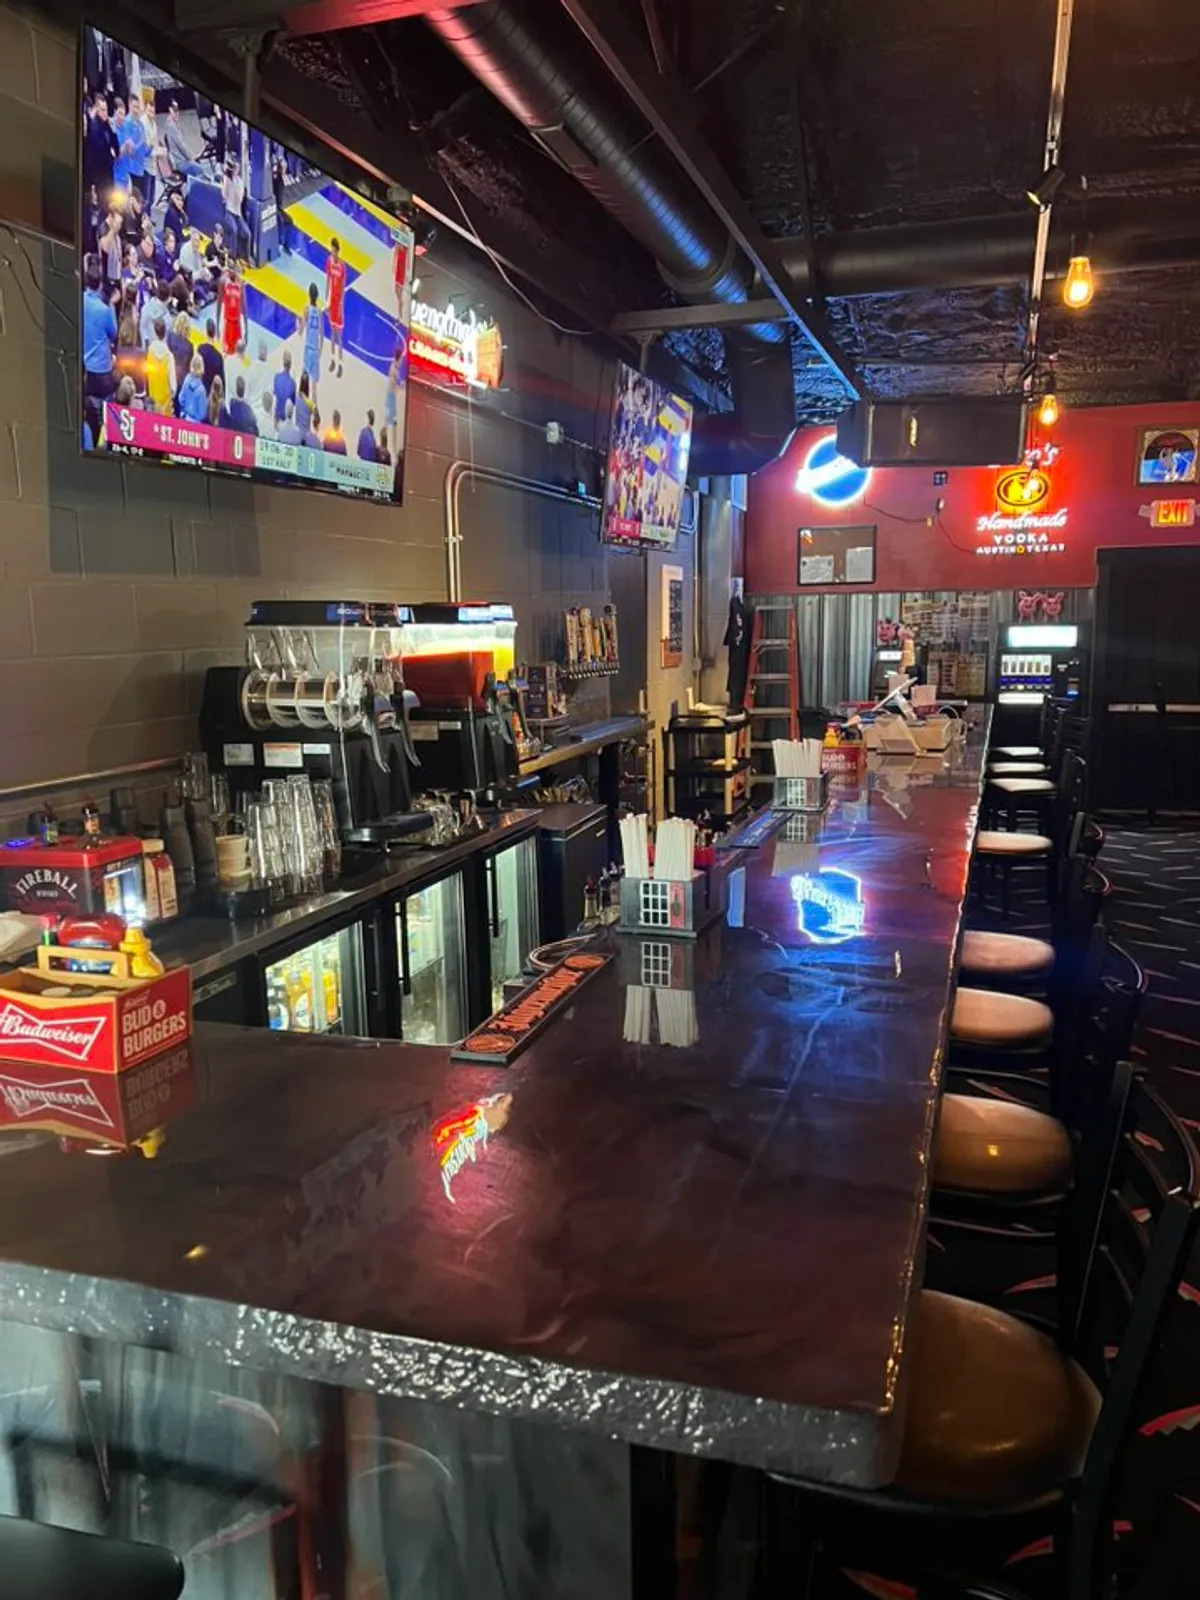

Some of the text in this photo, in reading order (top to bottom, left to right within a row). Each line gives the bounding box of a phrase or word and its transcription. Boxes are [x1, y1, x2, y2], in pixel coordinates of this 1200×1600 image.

[160, 425, 175, 443] ST.
[177, 428, 210, 450] JOHN'S
[233, 435, 243, 460] 0
[976, 507, 1068, 532] Handmade
[1158, 501, 1190, 523] EXIT
[993, 533, 1049, 544] VODKA
[1027, 543, 1065, 553] TEXAS
[15, 868, 79, 900] FIREBALL
[1, 1012, 95, 1047] Budweiser
[123, 1004, 152, 1036] BUD
[153, 999, 167, 1019] &
[123, 1011, 187, 1058] BURGERS
